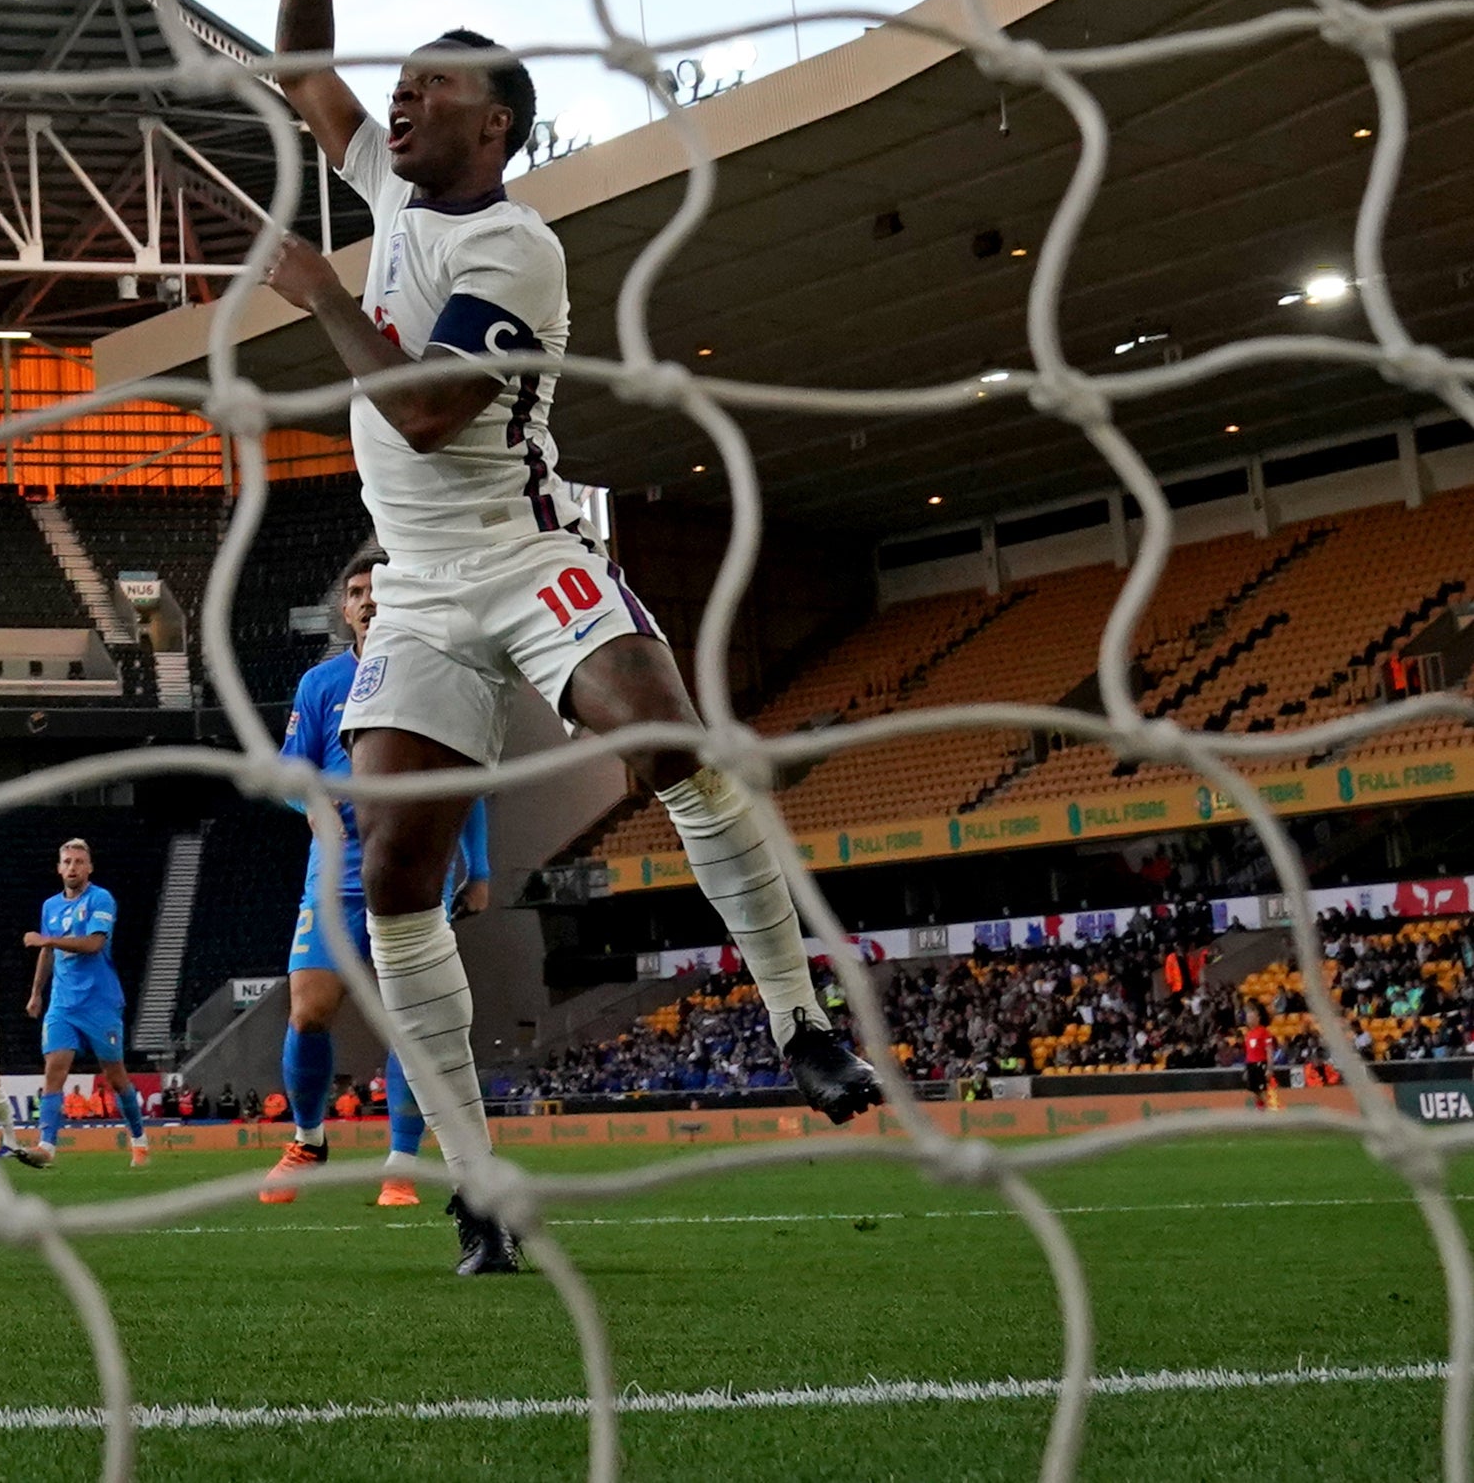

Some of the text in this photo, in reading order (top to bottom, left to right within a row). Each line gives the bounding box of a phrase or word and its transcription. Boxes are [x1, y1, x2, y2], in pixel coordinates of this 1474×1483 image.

[484, 321, 518, 357] C
[536, 567, 603, 628] 10
[292, 908, 314, 954] 2
[1419, 1091, 1474, 1119] UEFA
